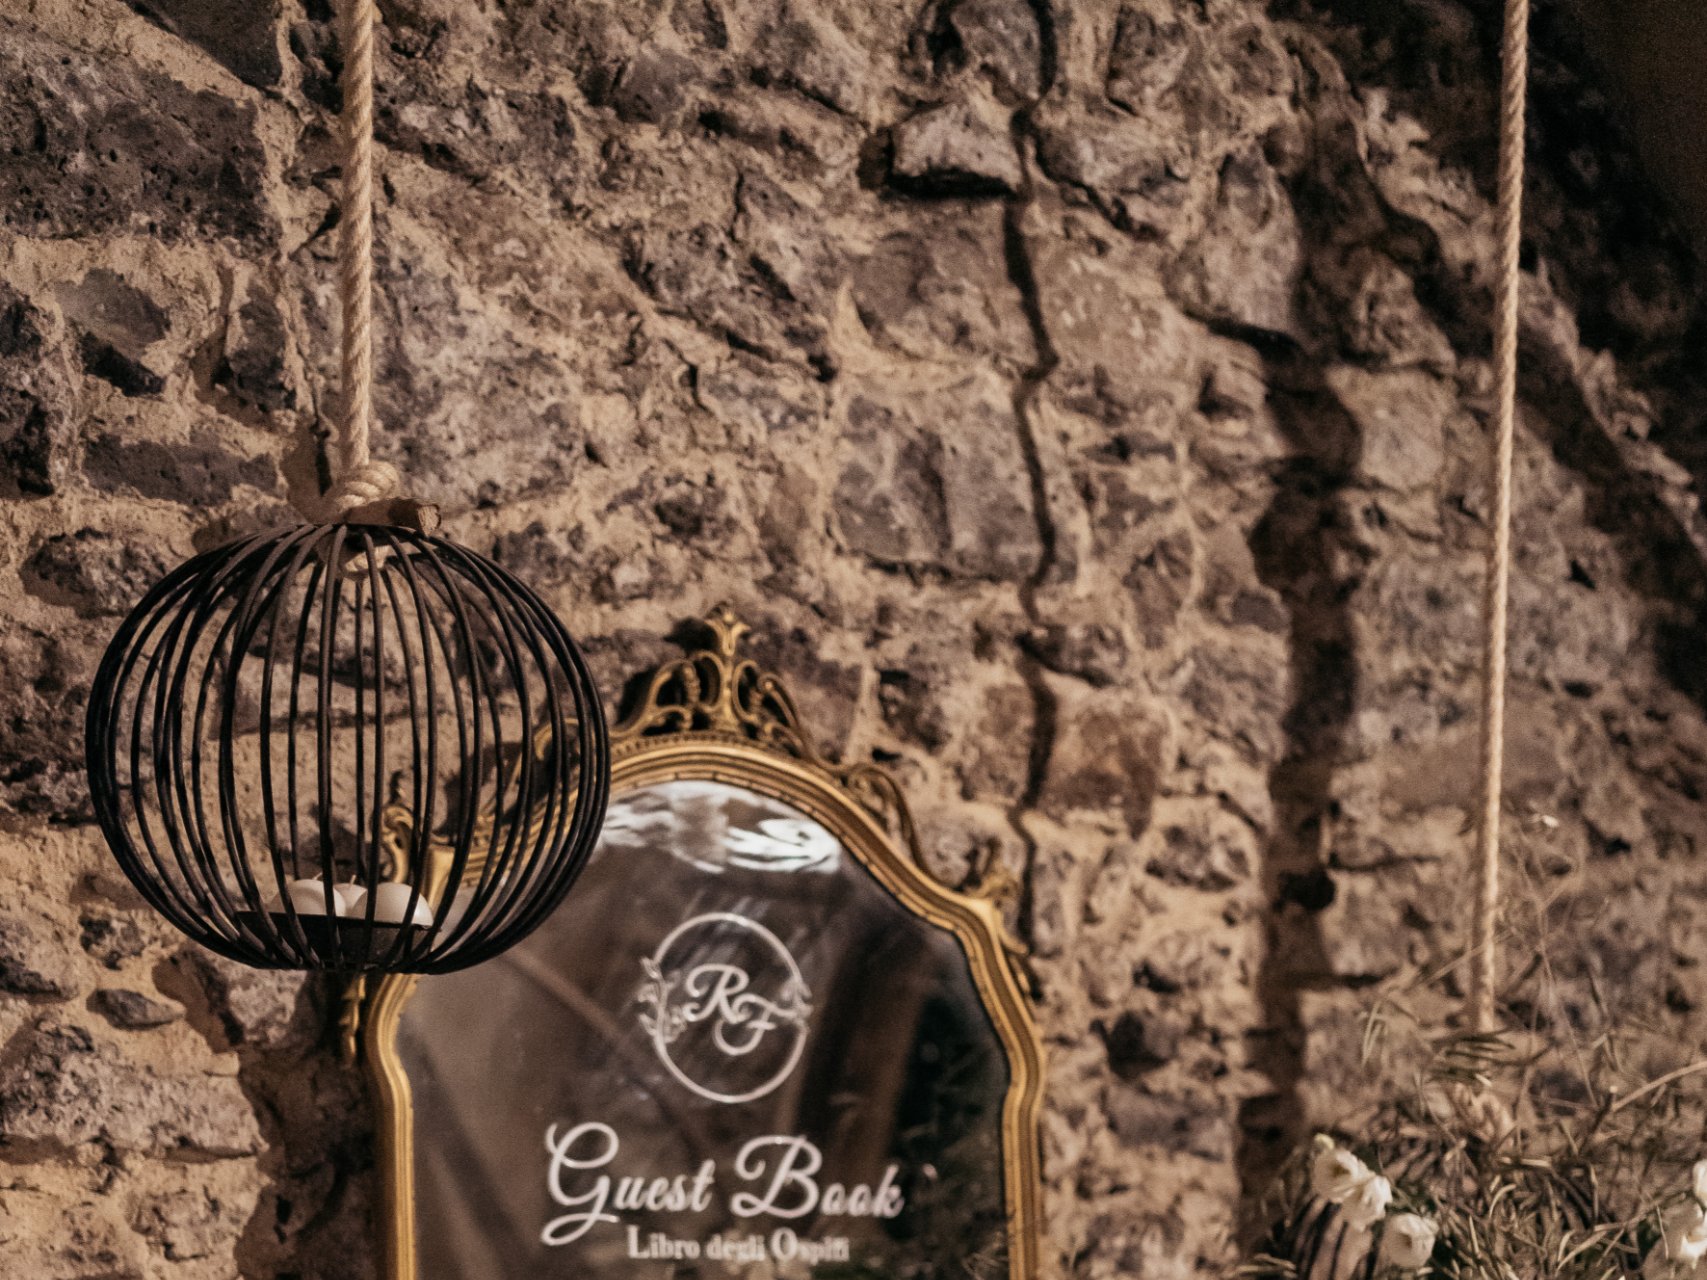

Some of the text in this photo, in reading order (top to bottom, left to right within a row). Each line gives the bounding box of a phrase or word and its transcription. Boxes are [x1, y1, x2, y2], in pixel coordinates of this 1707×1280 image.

[541, 1121, 904, 1247] Guest Book
[626, 1224, 700, 1260] Libro
